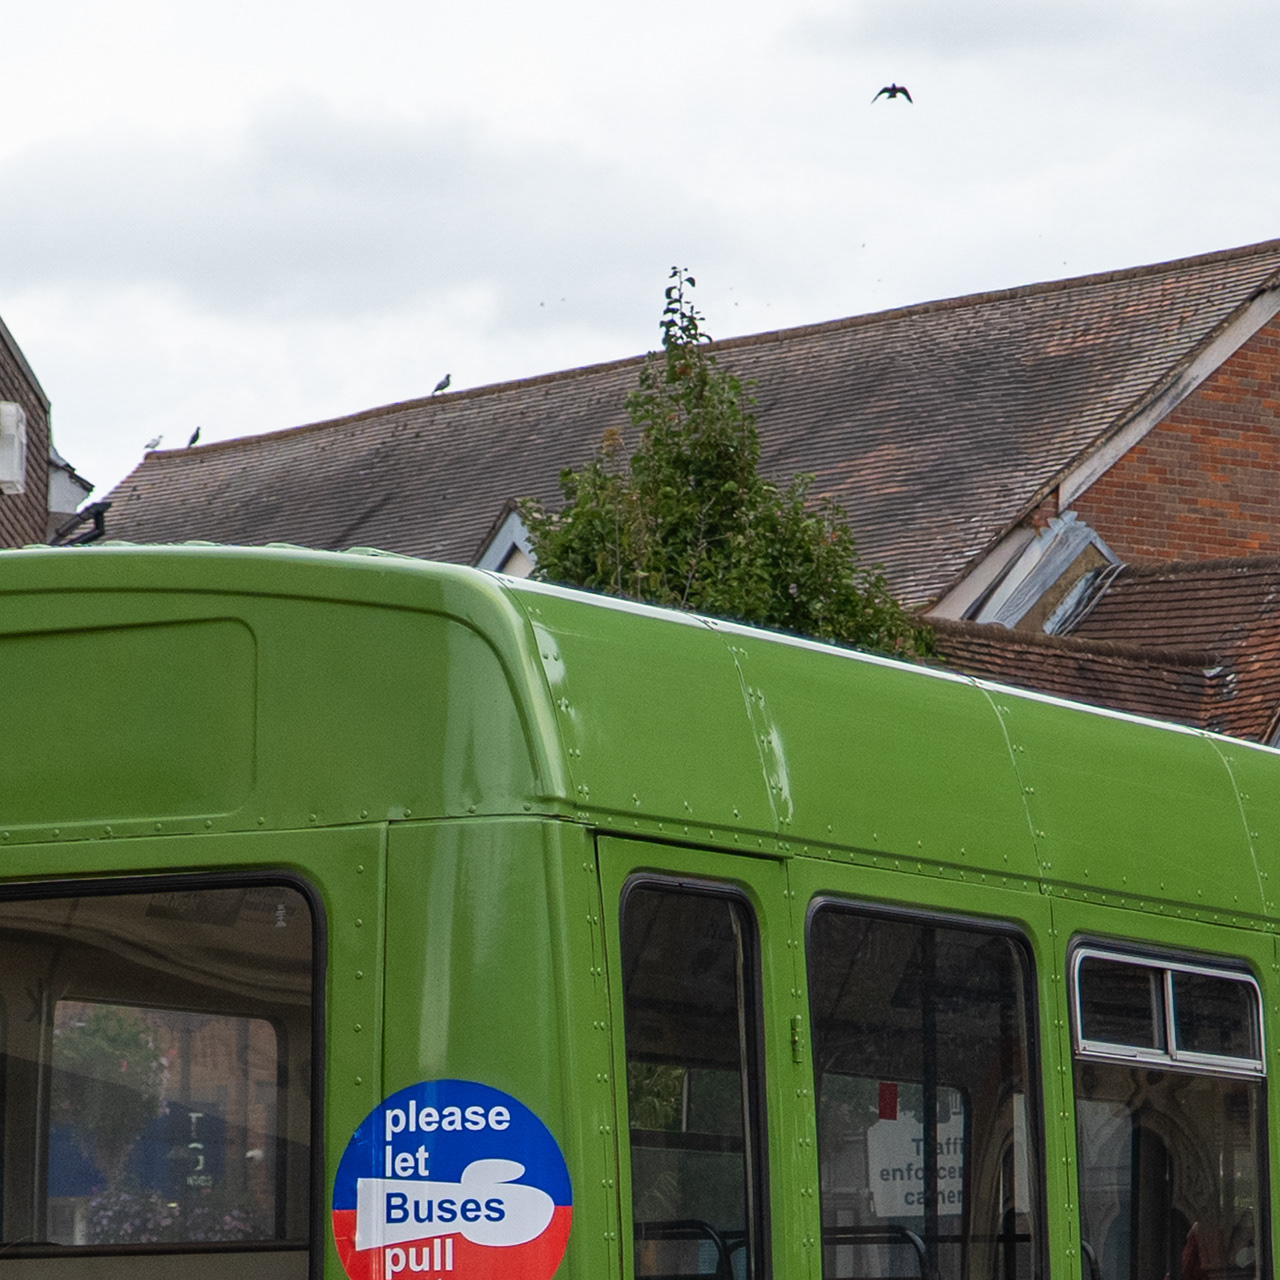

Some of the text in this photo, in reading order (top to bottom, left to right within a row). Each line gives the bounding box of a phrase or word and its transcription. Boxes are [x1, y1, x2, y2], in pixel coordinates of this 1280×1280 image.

[385, 1100, 511, 1142] please
[385, 1144, 430, 1178] let
[385, 1191, 507, 1224] Buses
[385, 1238, 454, 1280] pull
